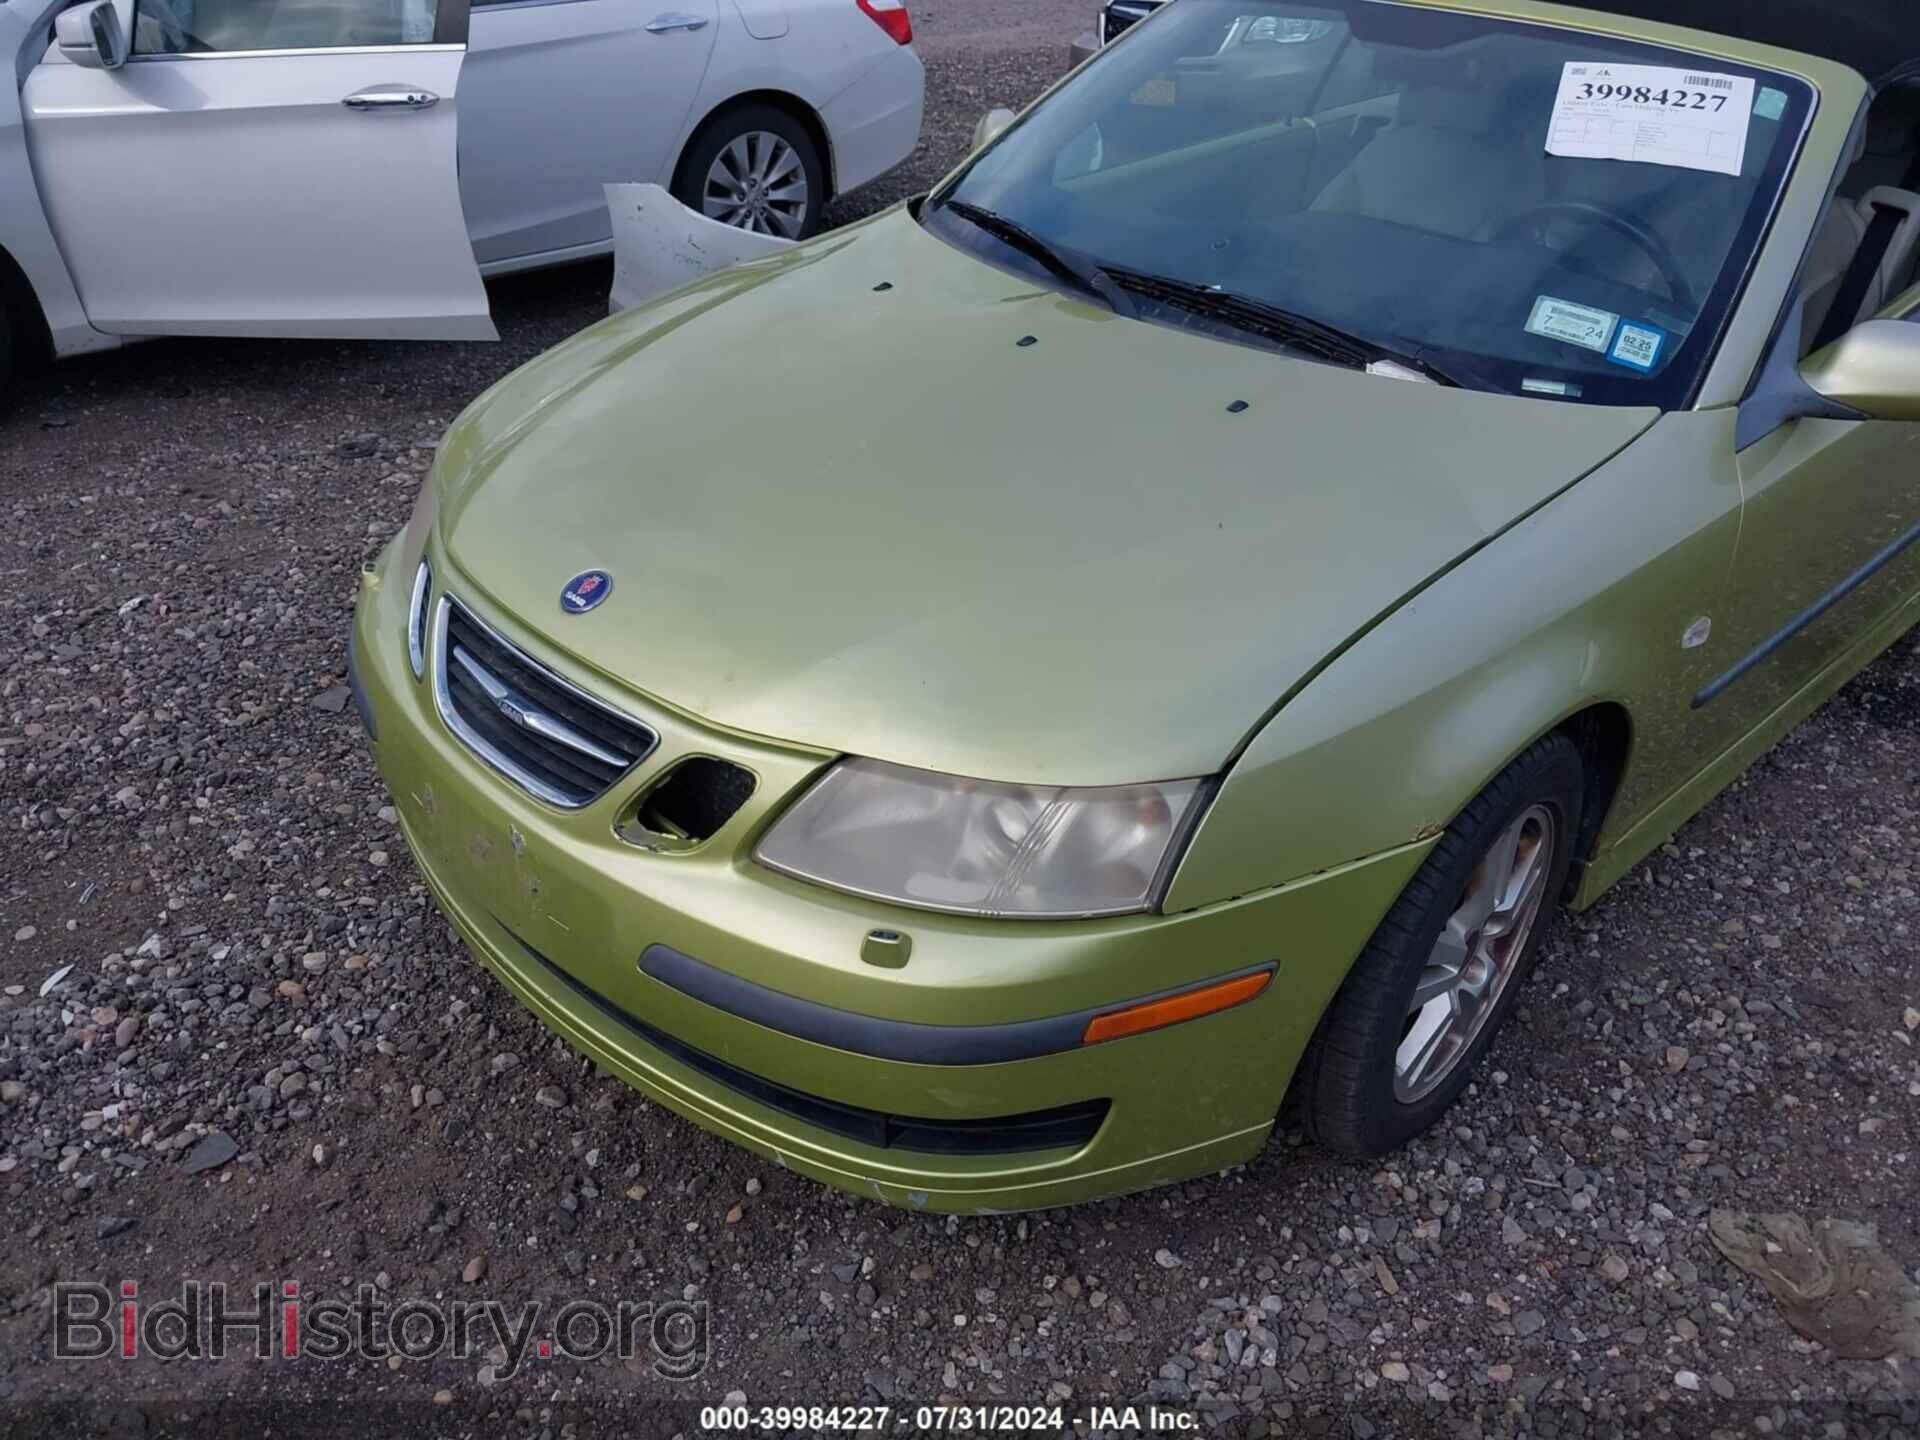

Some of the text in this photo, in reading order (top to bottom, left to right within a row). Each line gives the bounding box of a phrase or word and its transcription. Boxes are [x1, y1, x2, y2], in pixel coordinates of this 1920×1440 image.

[1576, 83, 1728, 112] 39984227
[1543, 314, 1553, 325] 7
[1585, 326, 1604, 339] 24
[565, 590, 587, 607] SAAB
